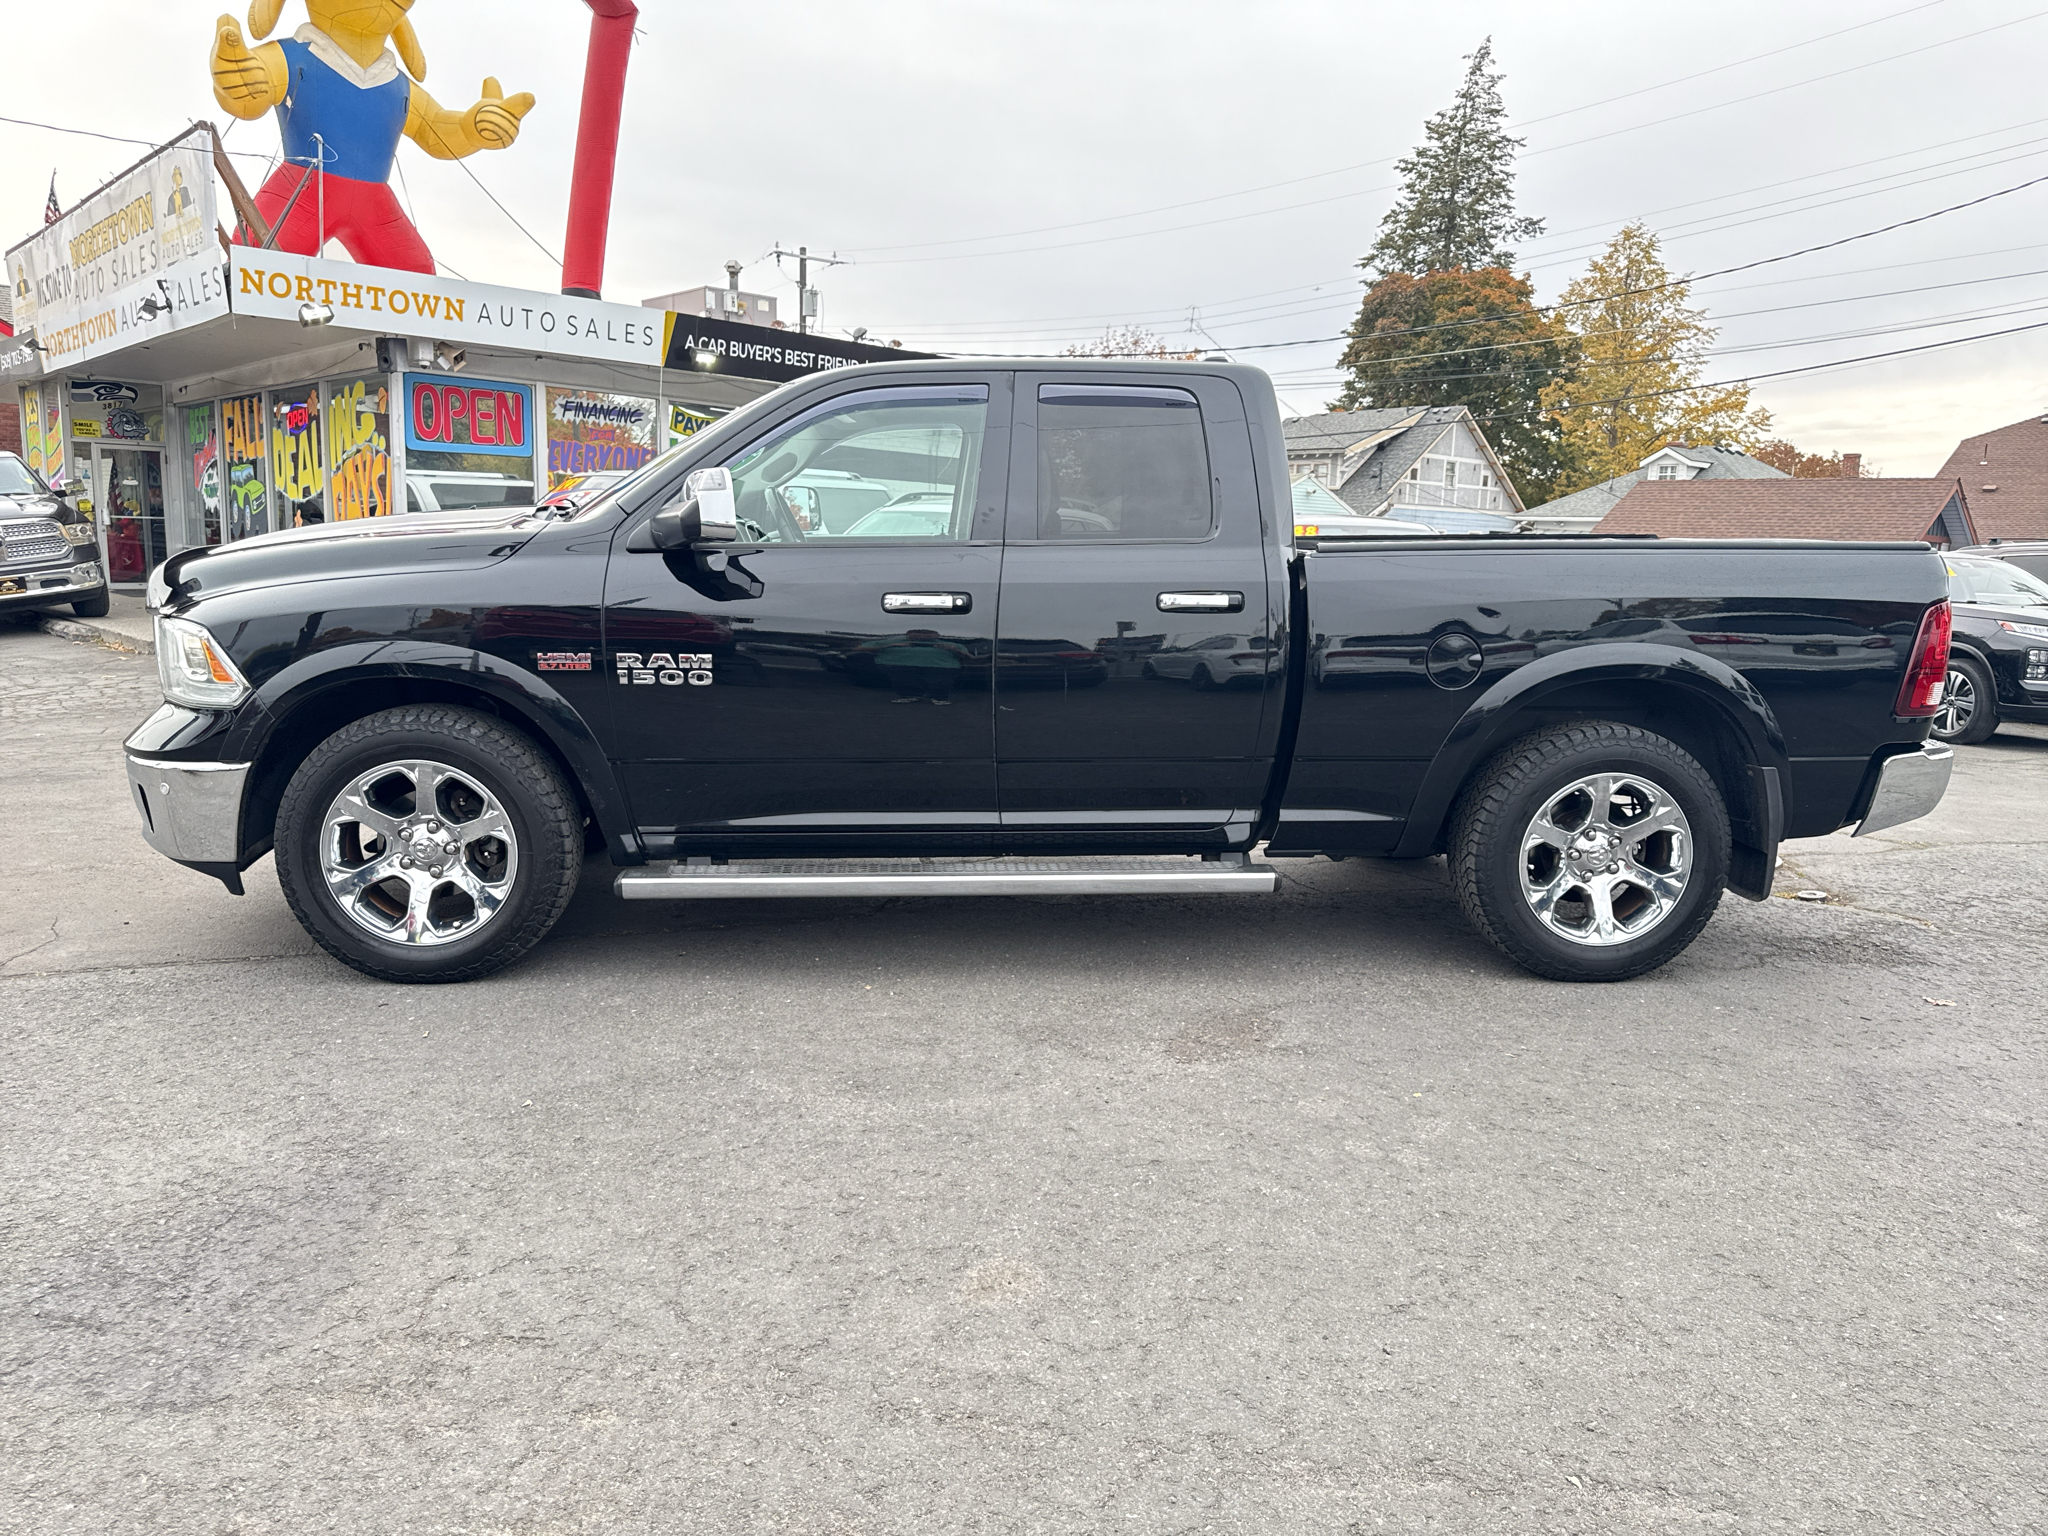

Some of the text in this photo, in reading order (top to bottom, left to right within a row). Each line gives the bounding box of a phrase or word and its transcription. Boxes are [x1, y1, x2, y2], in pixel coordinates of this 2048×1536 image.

[69, 191, 154, 272] NORTHTOWN
[74, 240, 157, 305] AUTO SALES
[239, 267, 654, 346] NORTHTOWN AUTO SALES
[42, 308, 117, 360] NORTHTOWN
[121, 292, 158, 332] AU
[685, 334, 695, 350] A
[699, 336, 727, 356] CAR
[729, 341, 782, 364] BUYER'S
[784, 350, 816, 369] BEST
[102, 401, 123, 410] 3817
[287, 408, 309, 429] OPEN
[413, 383, 525, 447] OPEN
[562, 400, 645, 424] FINANCING
[189, 405, 210, 445] BEST
[222, 395, 265, 463] FALL
[591, 429, 614, 441] FOR
[537, 652, 592, 663] HEMI
[616, 652, 713, 669] RAM
[616, 669, 713, 686] 1500
